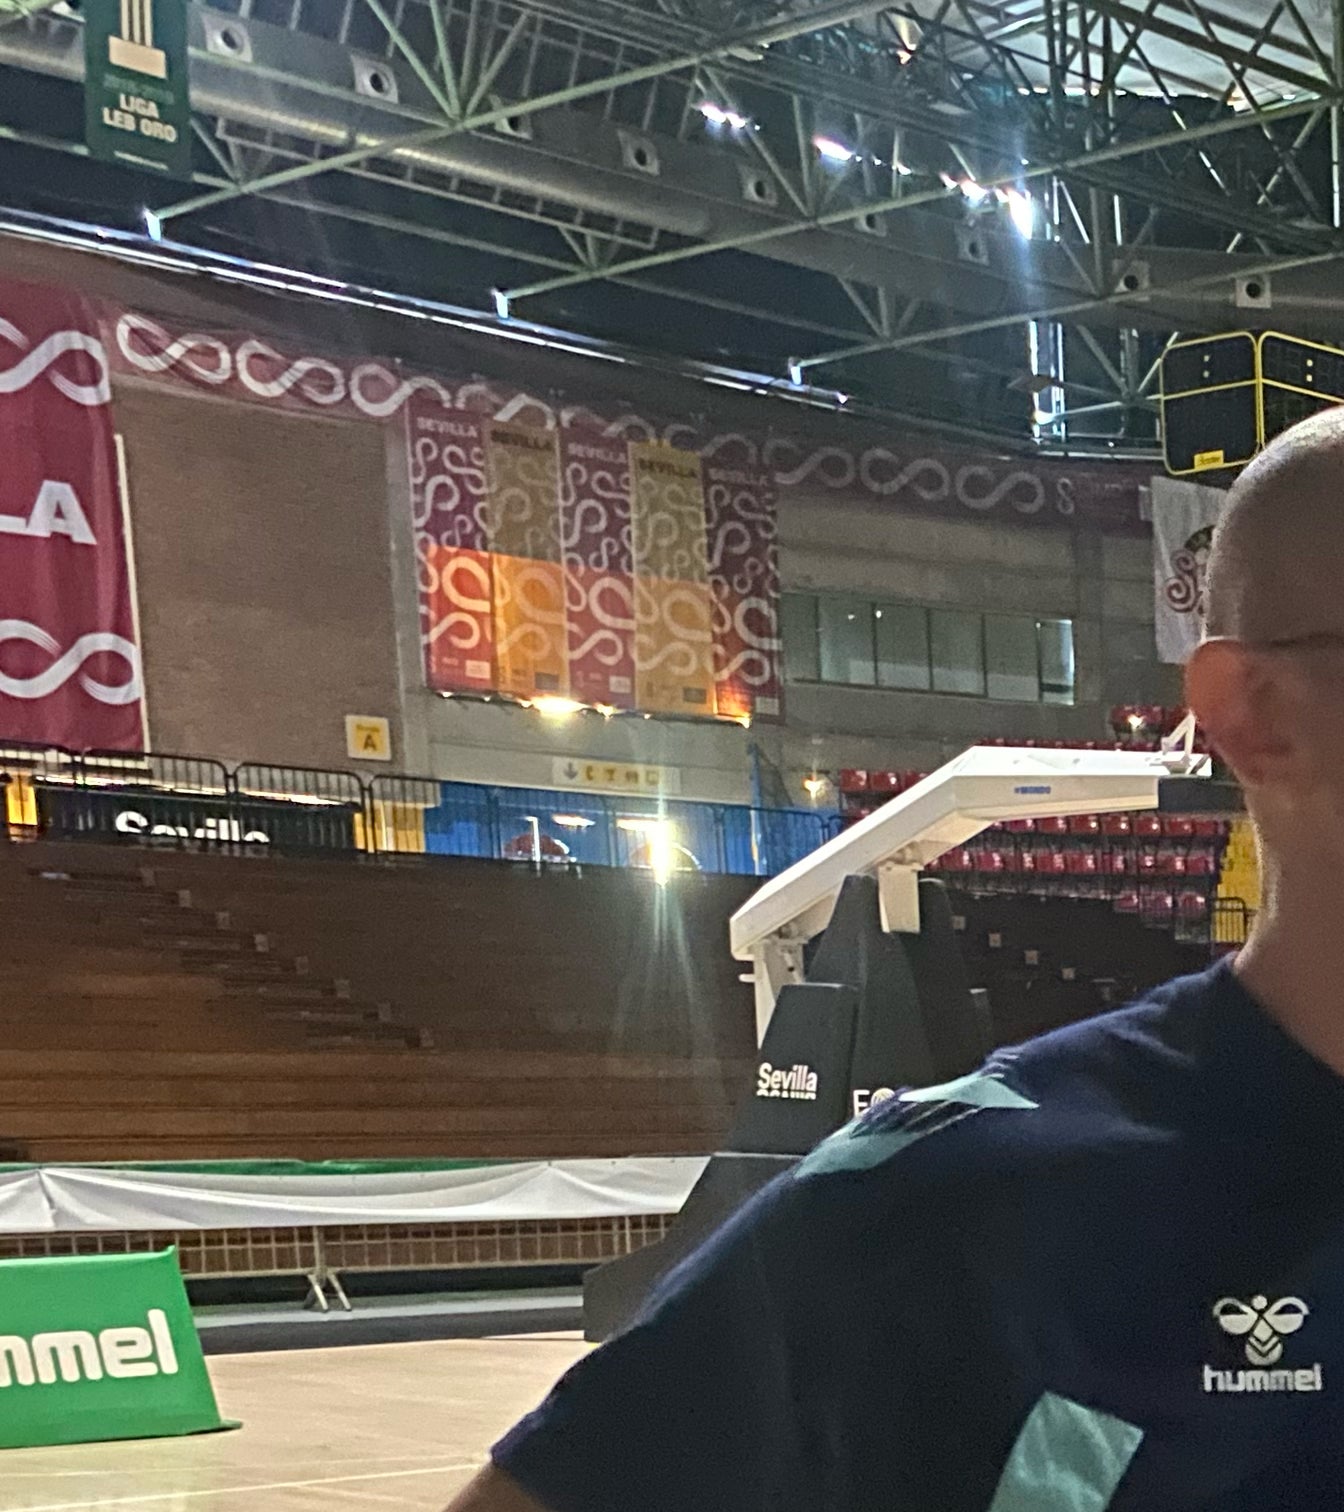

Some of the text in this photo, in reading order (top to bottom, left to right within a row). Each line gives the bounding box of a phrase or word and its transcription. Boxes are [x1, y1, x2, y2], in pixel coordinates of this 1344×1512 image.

[120, 93, 161, 119] LIGA
[102, 106, 178, 143] LEB ORO
[363, 733, 377, 751] A
[757, 1062, 818, 1092] Sevilla
[1203, 1363, 1322, 1392] hummel
